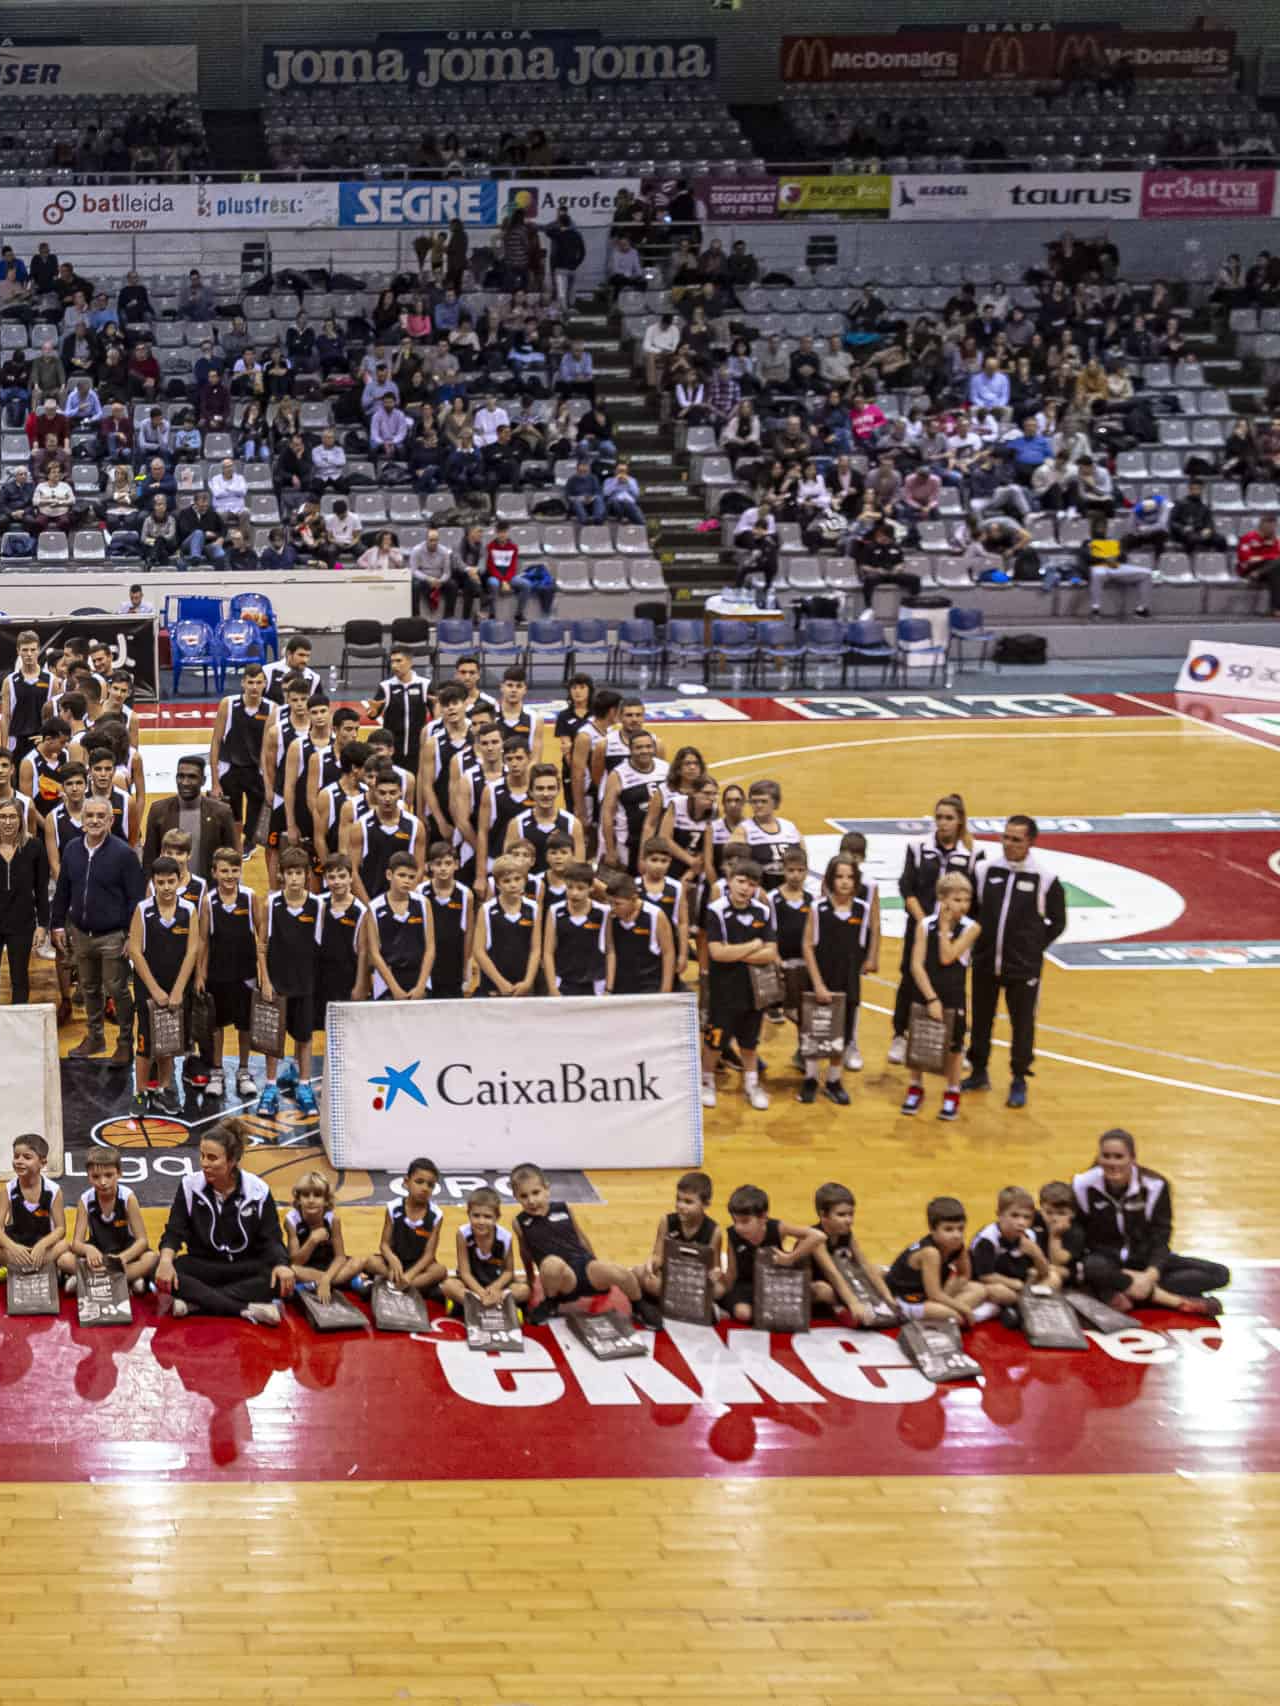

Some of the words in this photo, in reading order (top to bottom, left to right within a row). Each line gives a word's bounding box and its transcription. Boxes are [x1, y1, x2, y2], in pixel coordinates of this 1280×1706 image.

[831, 51, 960, 69] McDonald's
[82, 191, 175, 213] batlleida
[353, 187, 481, 224] SEGRE
[1010, 185, 1132, 206] taurus
[111, 218, 148, 229] TUDOR
[435, 1061, 663, 1107] CaixaBank
[63, 1151, 206, 1184] Lga
